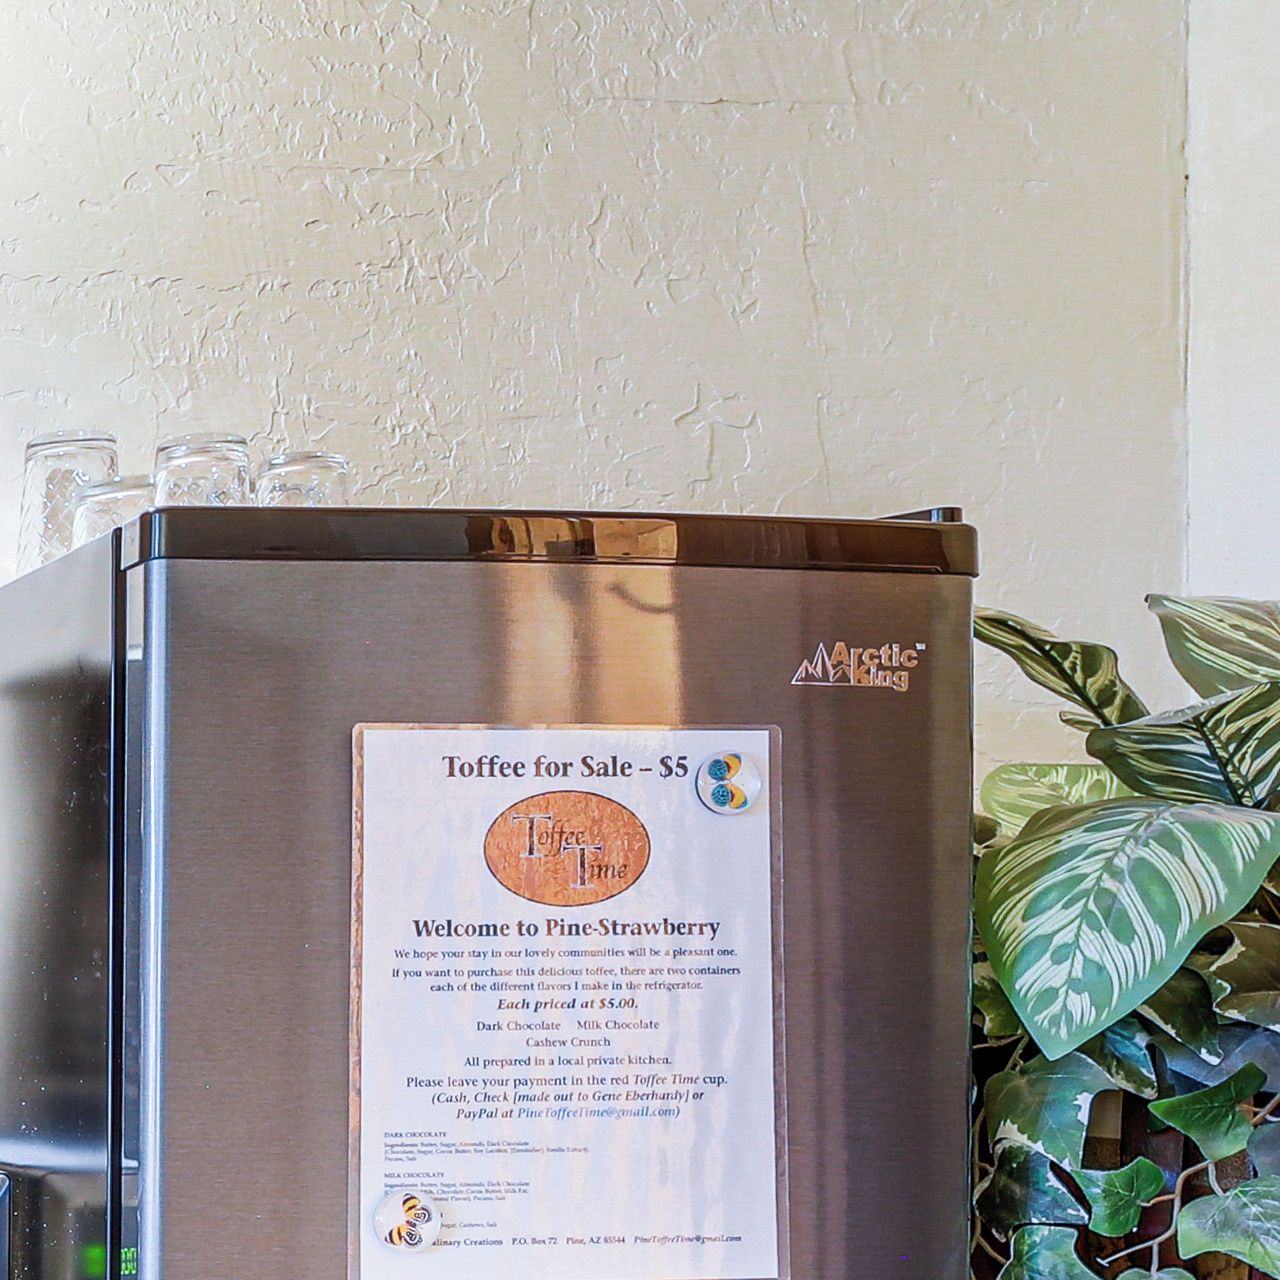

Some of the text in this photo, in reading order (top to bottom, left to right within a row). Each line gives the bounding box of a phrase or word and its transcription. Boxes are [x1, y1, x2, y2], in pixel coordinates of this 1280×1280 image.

[830, 641, 918, 668] Arctic
[852, 663, 909, 692] King
[441, 754, 526, 777] Toffee
[533, 754, 574, 777] for
[580, 755, 633, 777] Sale
[658, 755, 688, 778] $5
[511, 812, 586, 858] Toffee
[562, 844, 628, 890] Time
[412, 918, 720, 940] Welcome to Pine-Strawberry
[393, 949, 411, 958] We
[412, 948, 439, 960] hope
[440, 950, 465, 960] your
[466, 950, 489, 960] stay
[490, 948, 502, 957] in
[524, 948, 556, 957] lovely
[557, 948, 625, 956] communities
[626, 947, 646, 956] will
[648, 947, 661, 956] be
[671, 947, 715, 959] pleasant
[391, 968, 400, 977] If
[402, 970, 422, 980] you
[424, 969, 451, 977] want
[466, 967, 513, 978] purchase
[515, 967, 536, 976] this
[537, 966, 583, 976] delicious
[584, 966, 618, 978] toffee,
[619, 966, 646, 976] there
[687, 966, 741, 974] containers
[429, 980, 703, 991] each of the different flavors I make in the refrigerator.
[496, 997, 638, 1012] Each priced at $5.00.
[476, 1019, 660, 1030] Dark Chocolate Milk Chocolate
[524, 1036, 611, 1047] Cashew Crunch
[463, 1056, 480, 1066] All
[482, 1056, 531, 1069] prepared
[533, 1056, 545, 1066] in
[556, 1055, 584, 1065] local
[586, 1056, 626, 1067] private
[627, 1054, 672, 1064] kitchen.
[406, 1073, 728, 1089] Please leave your payment in the red Toffee Time cup.
[430, 1092, 471, 1104] (Cash,
[473, 1091, 510, 1102] Check
[512, 1091, 550, 1104] [made
[552, 1092, 574, 1101] out
[576, 1091, 589, 1101] to
[591, 1090, 622, 1101] Gene
[691, 1091, 705, 1100] or
[455, 1108, 499, 1120] PayPal
[500, 1108, 514, 1118] at
[547, 1236, 558, 1245] 72
[565, 1236, 587, 1245] Pine,
